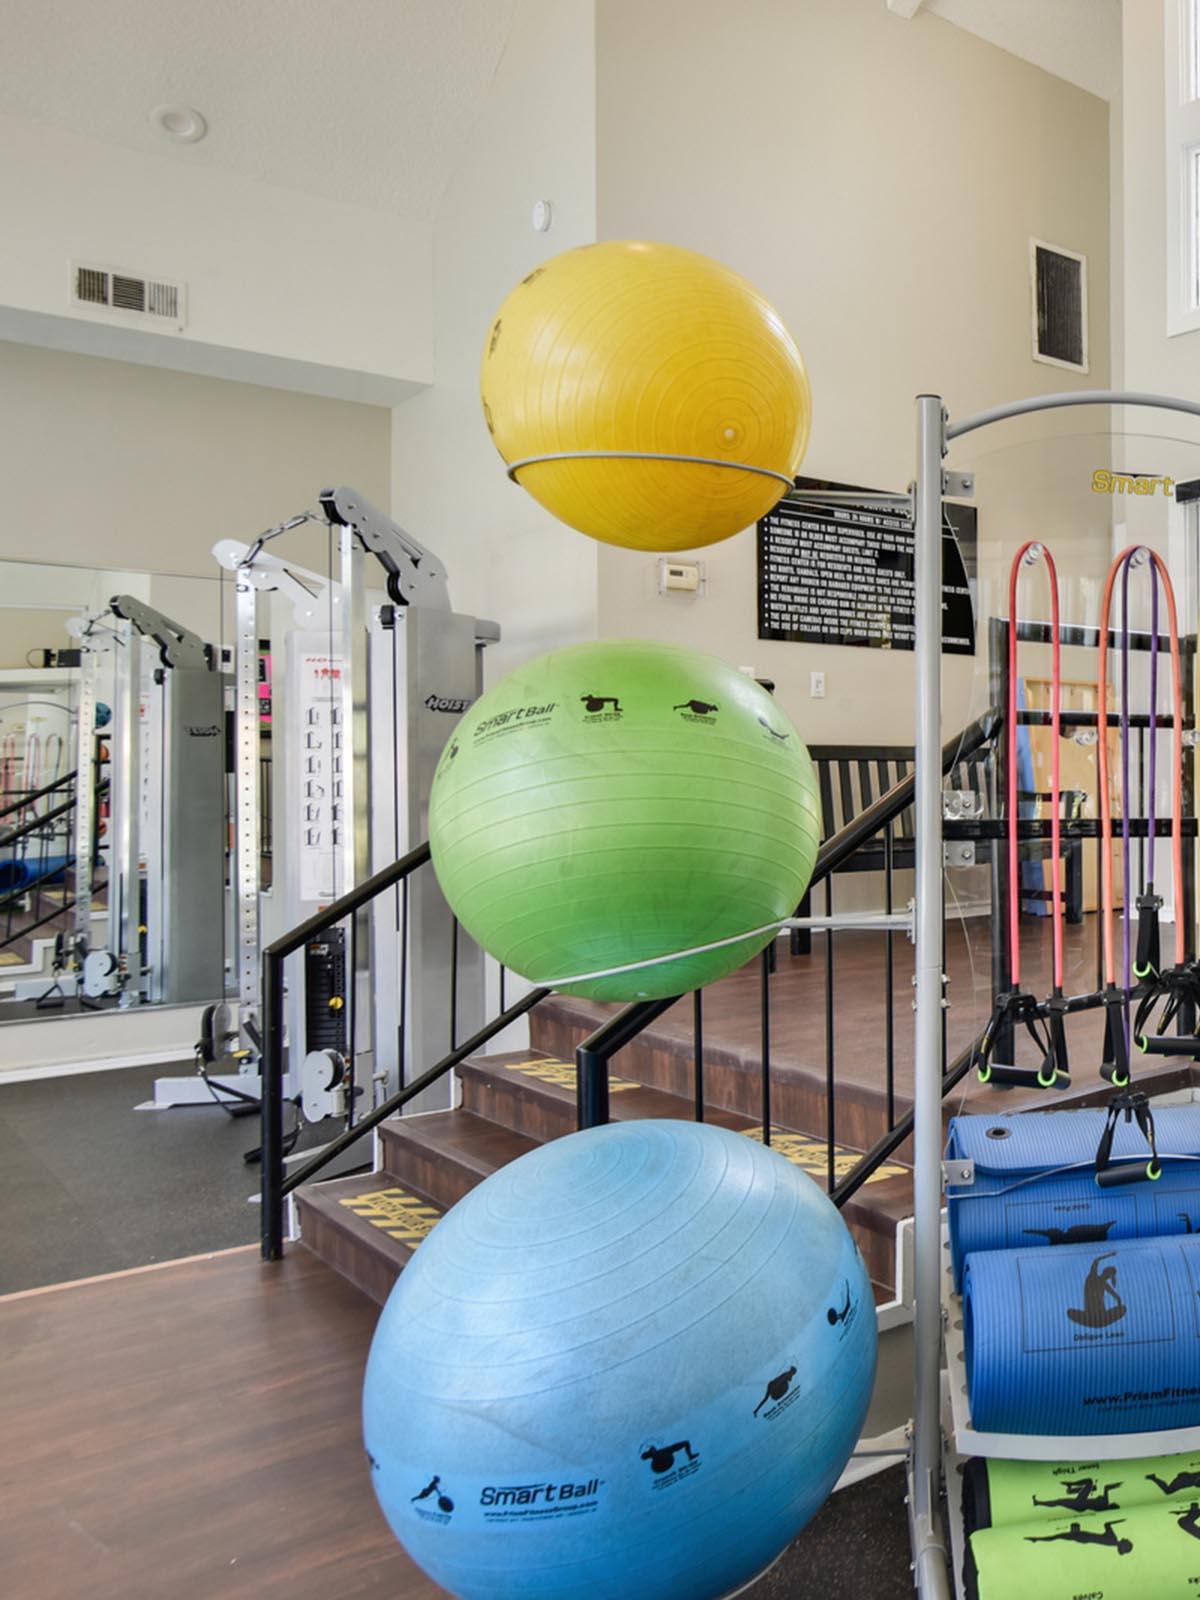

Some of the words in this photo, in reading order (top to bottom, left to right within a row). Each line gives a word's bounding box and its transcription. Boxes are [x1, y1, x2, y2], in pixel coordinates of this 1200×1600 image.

[1091, 469, 1174, 497] Smart
[426, 696, 470, 713] HOIST
[474, 707, 525, 737] Smart
[525, 703, 556, 718] Ball
[1073, 1332, 1103, 1342] Oblique
[480, 1484, 557, 1506] Smart
[559, 1479, 599, 1500] Ball
